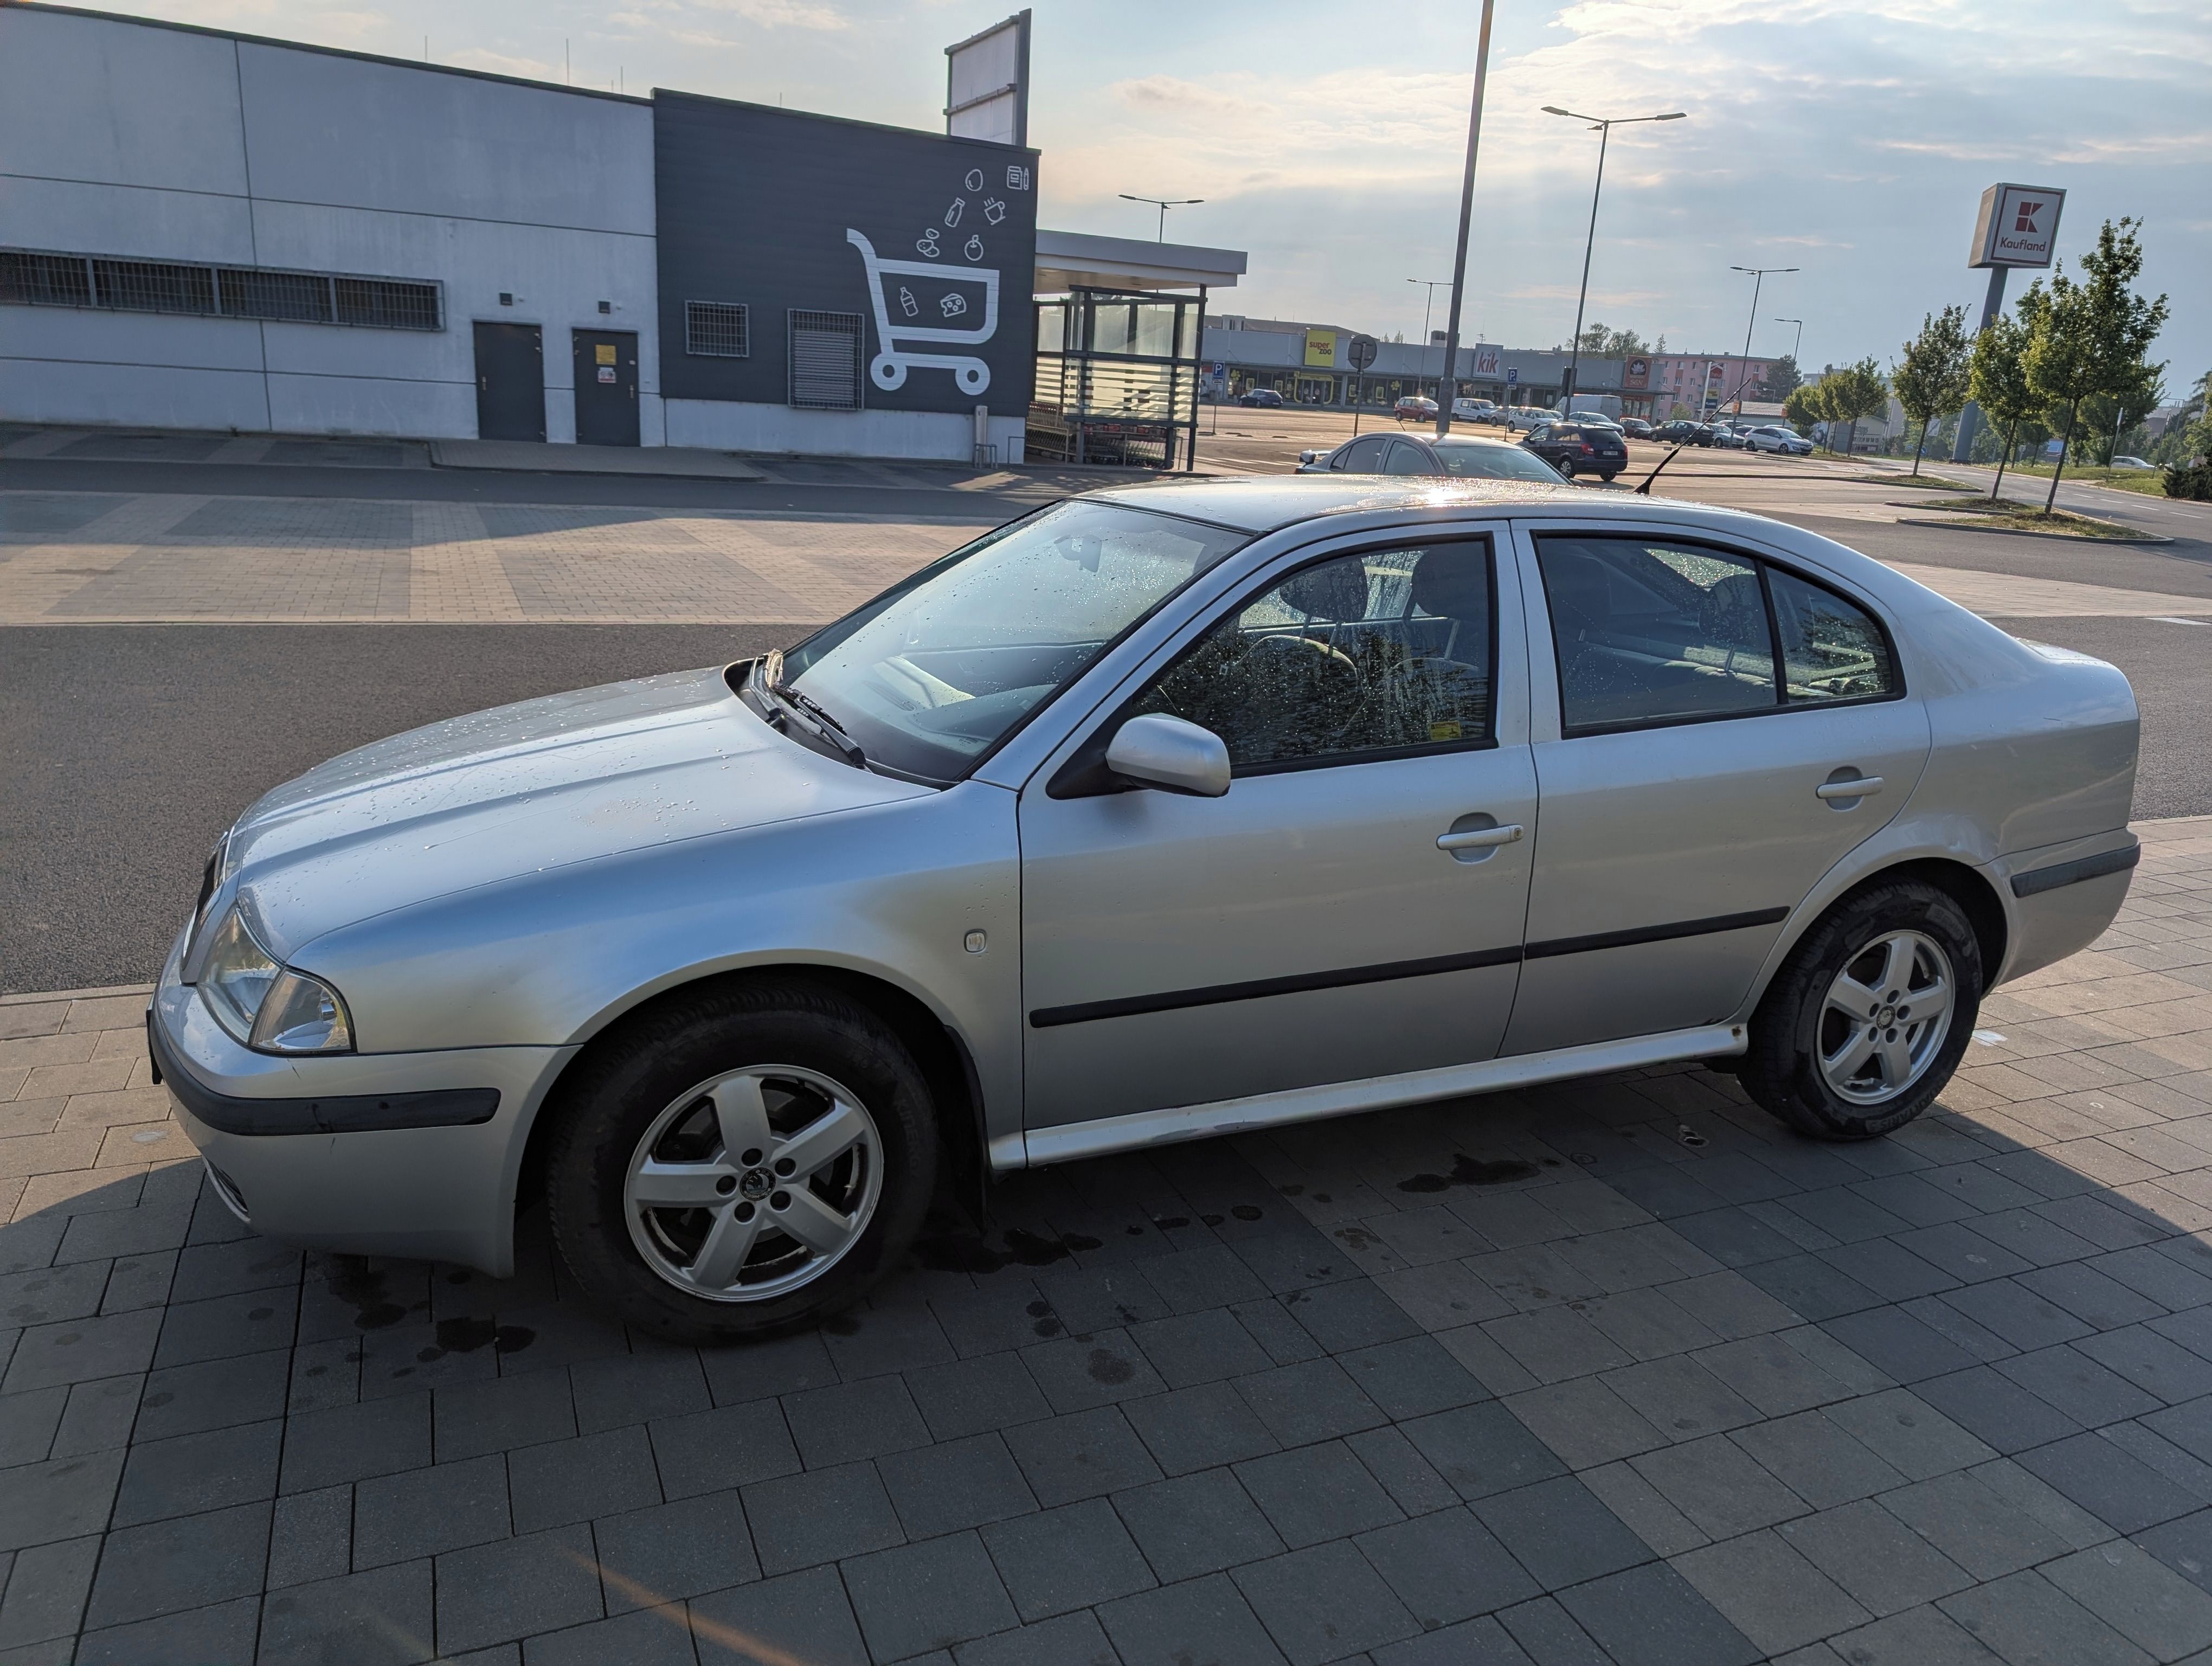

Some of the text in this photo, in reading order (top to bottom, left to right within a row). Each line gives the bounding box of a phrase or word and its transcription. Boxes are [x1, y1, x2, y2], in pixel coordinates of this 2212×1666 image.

[1999, 236, 2046, 252] Kaufland
[1477, 348, 1499, 373] kik
[1215, 363, 1223, 374] P
[1510, 370, 1516, 381] P
